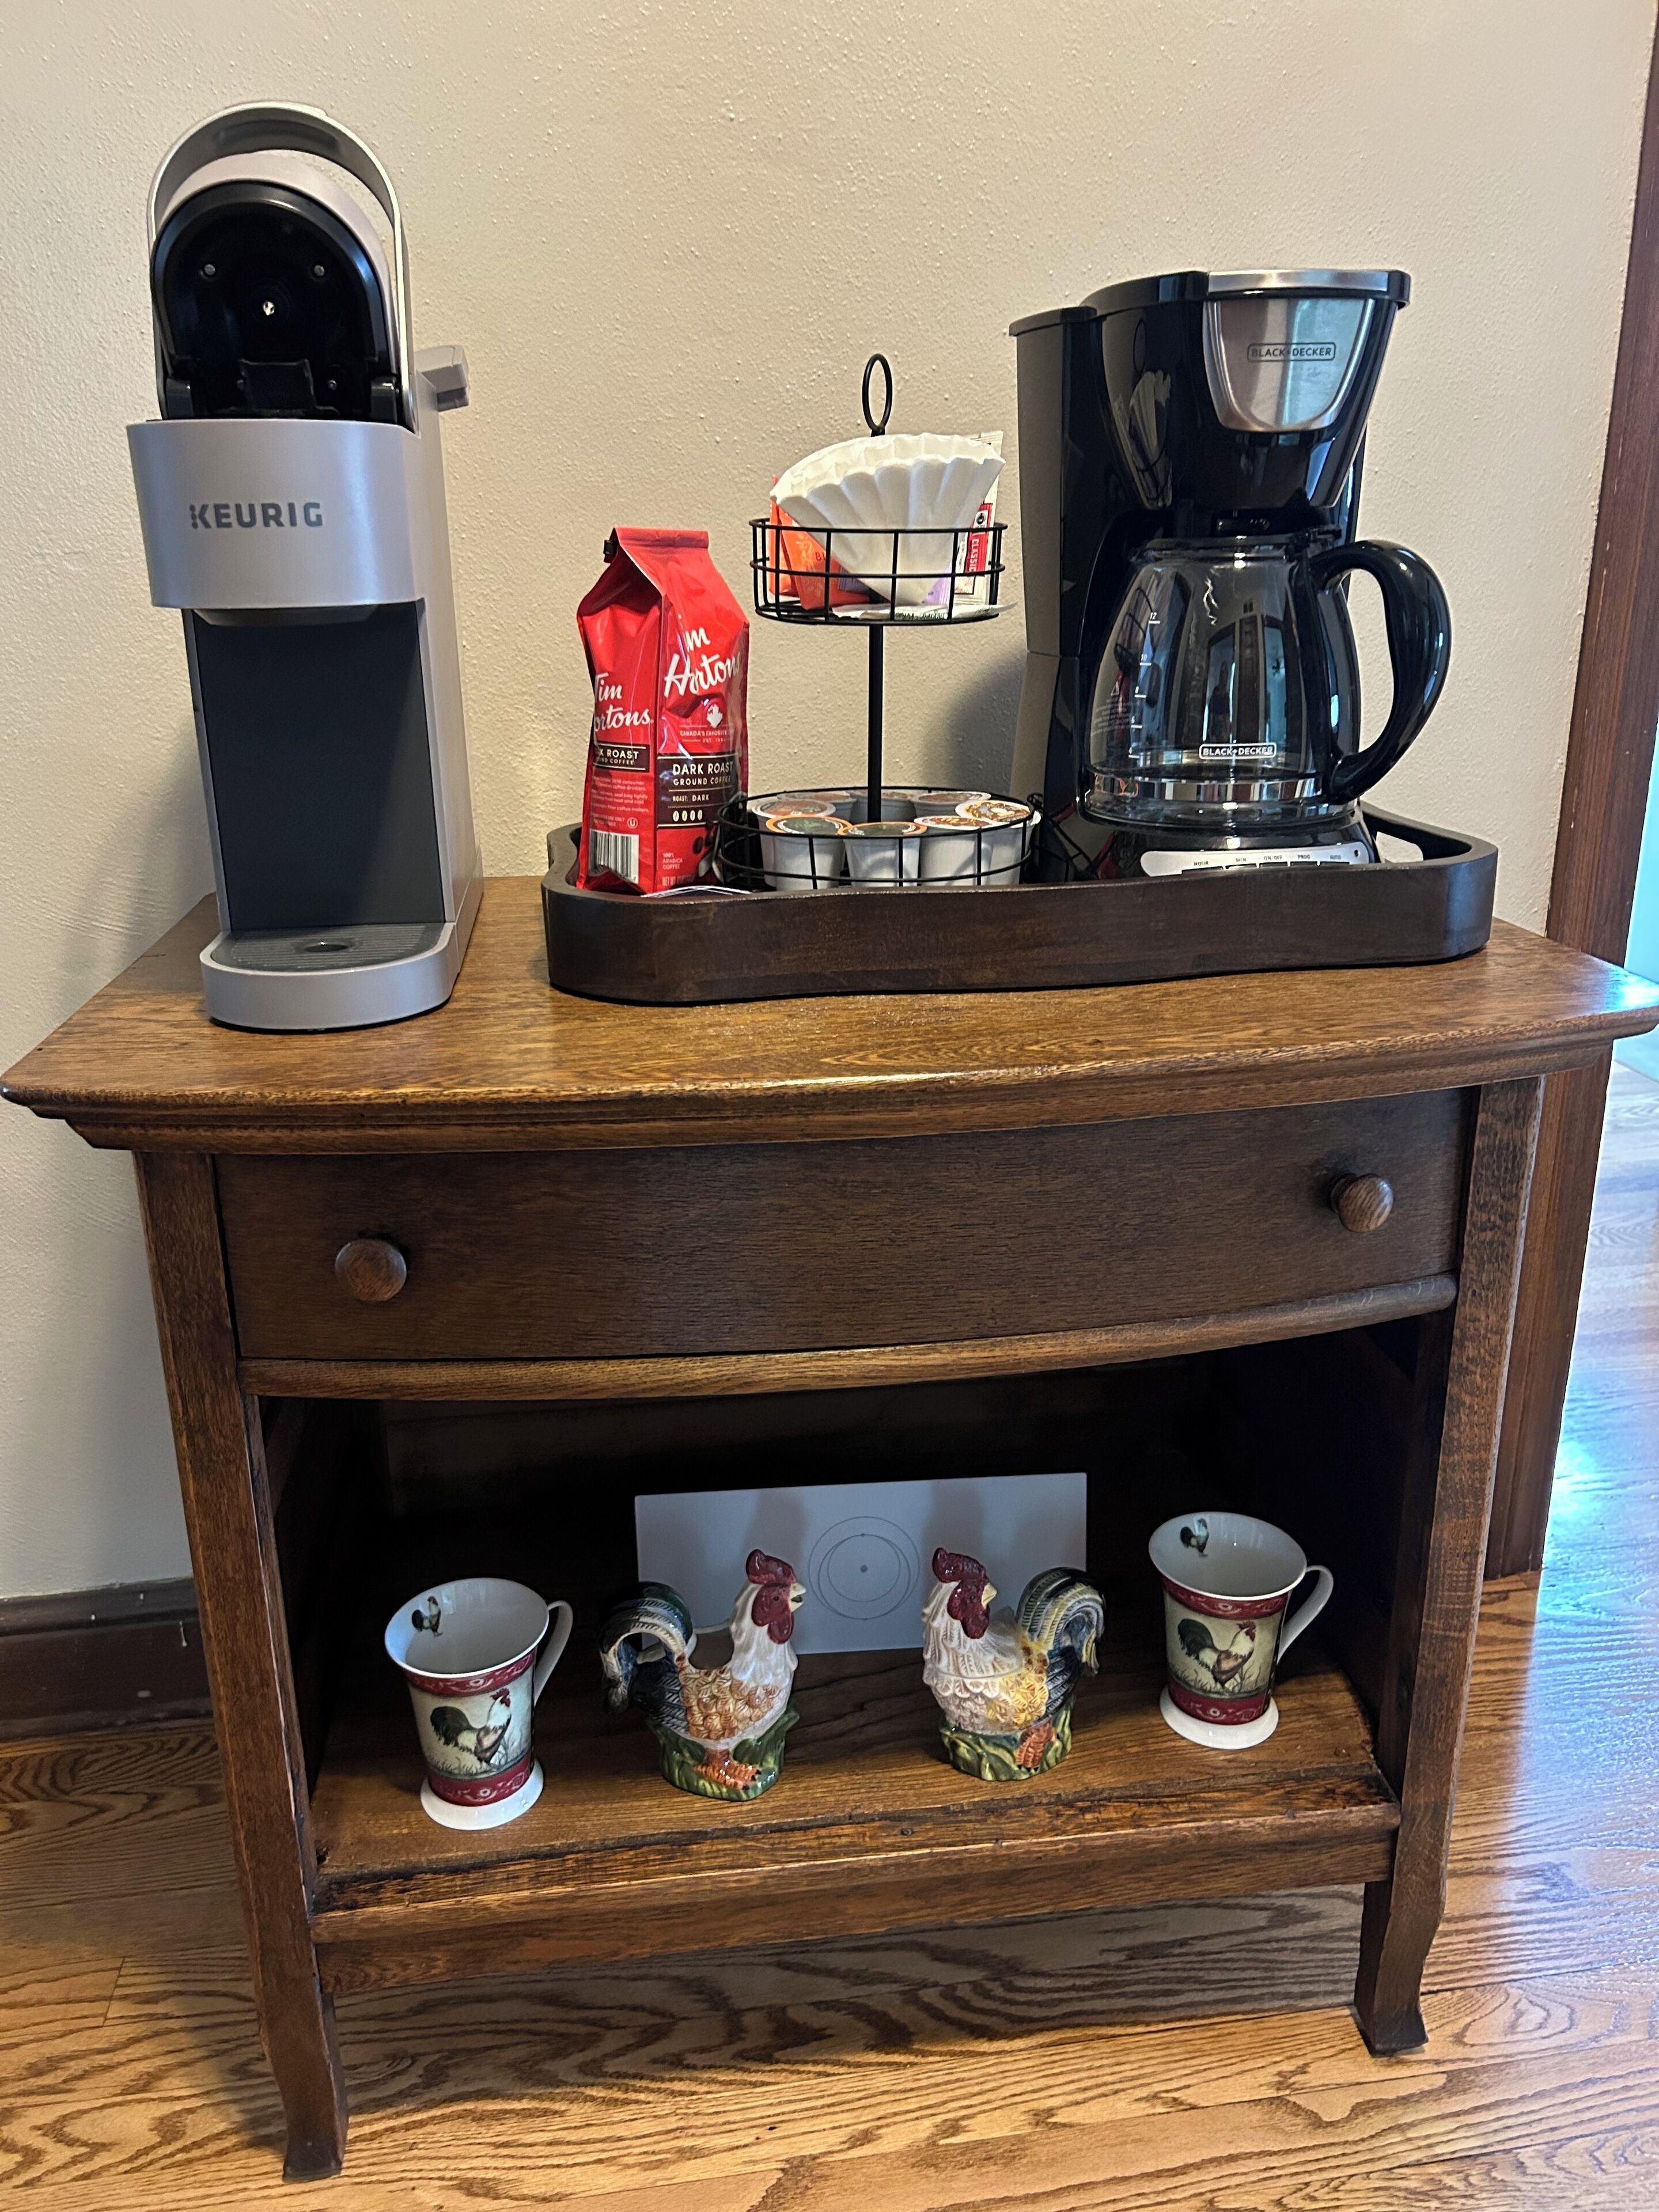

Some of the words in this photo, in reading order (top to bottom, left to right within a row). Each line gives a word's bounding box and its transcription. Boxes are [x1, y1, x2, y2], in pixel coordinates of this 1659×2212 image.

[1252, 347, 1331, 357] BLACK+DECKER
[190, 502, 323, 529] KEURIG
[969, 539, 979, 573] CLASSIC
[1150, 612, 1157, 620] 12
[1141, 653, 1147, 661] 10
[594, 672, 622, 703] Tim
[594, 704, 651, 732] ortons
[607, 749, 639, 760] ROAST
[1203, 747, 1273, 756] BLACK+DECKER
[673, 763, 703, 775] DARK
[708, 762, 733, 774] ROAST
[673, 778, 707, 786] GROUND
[710, 775, 731, 784] COFFEE
